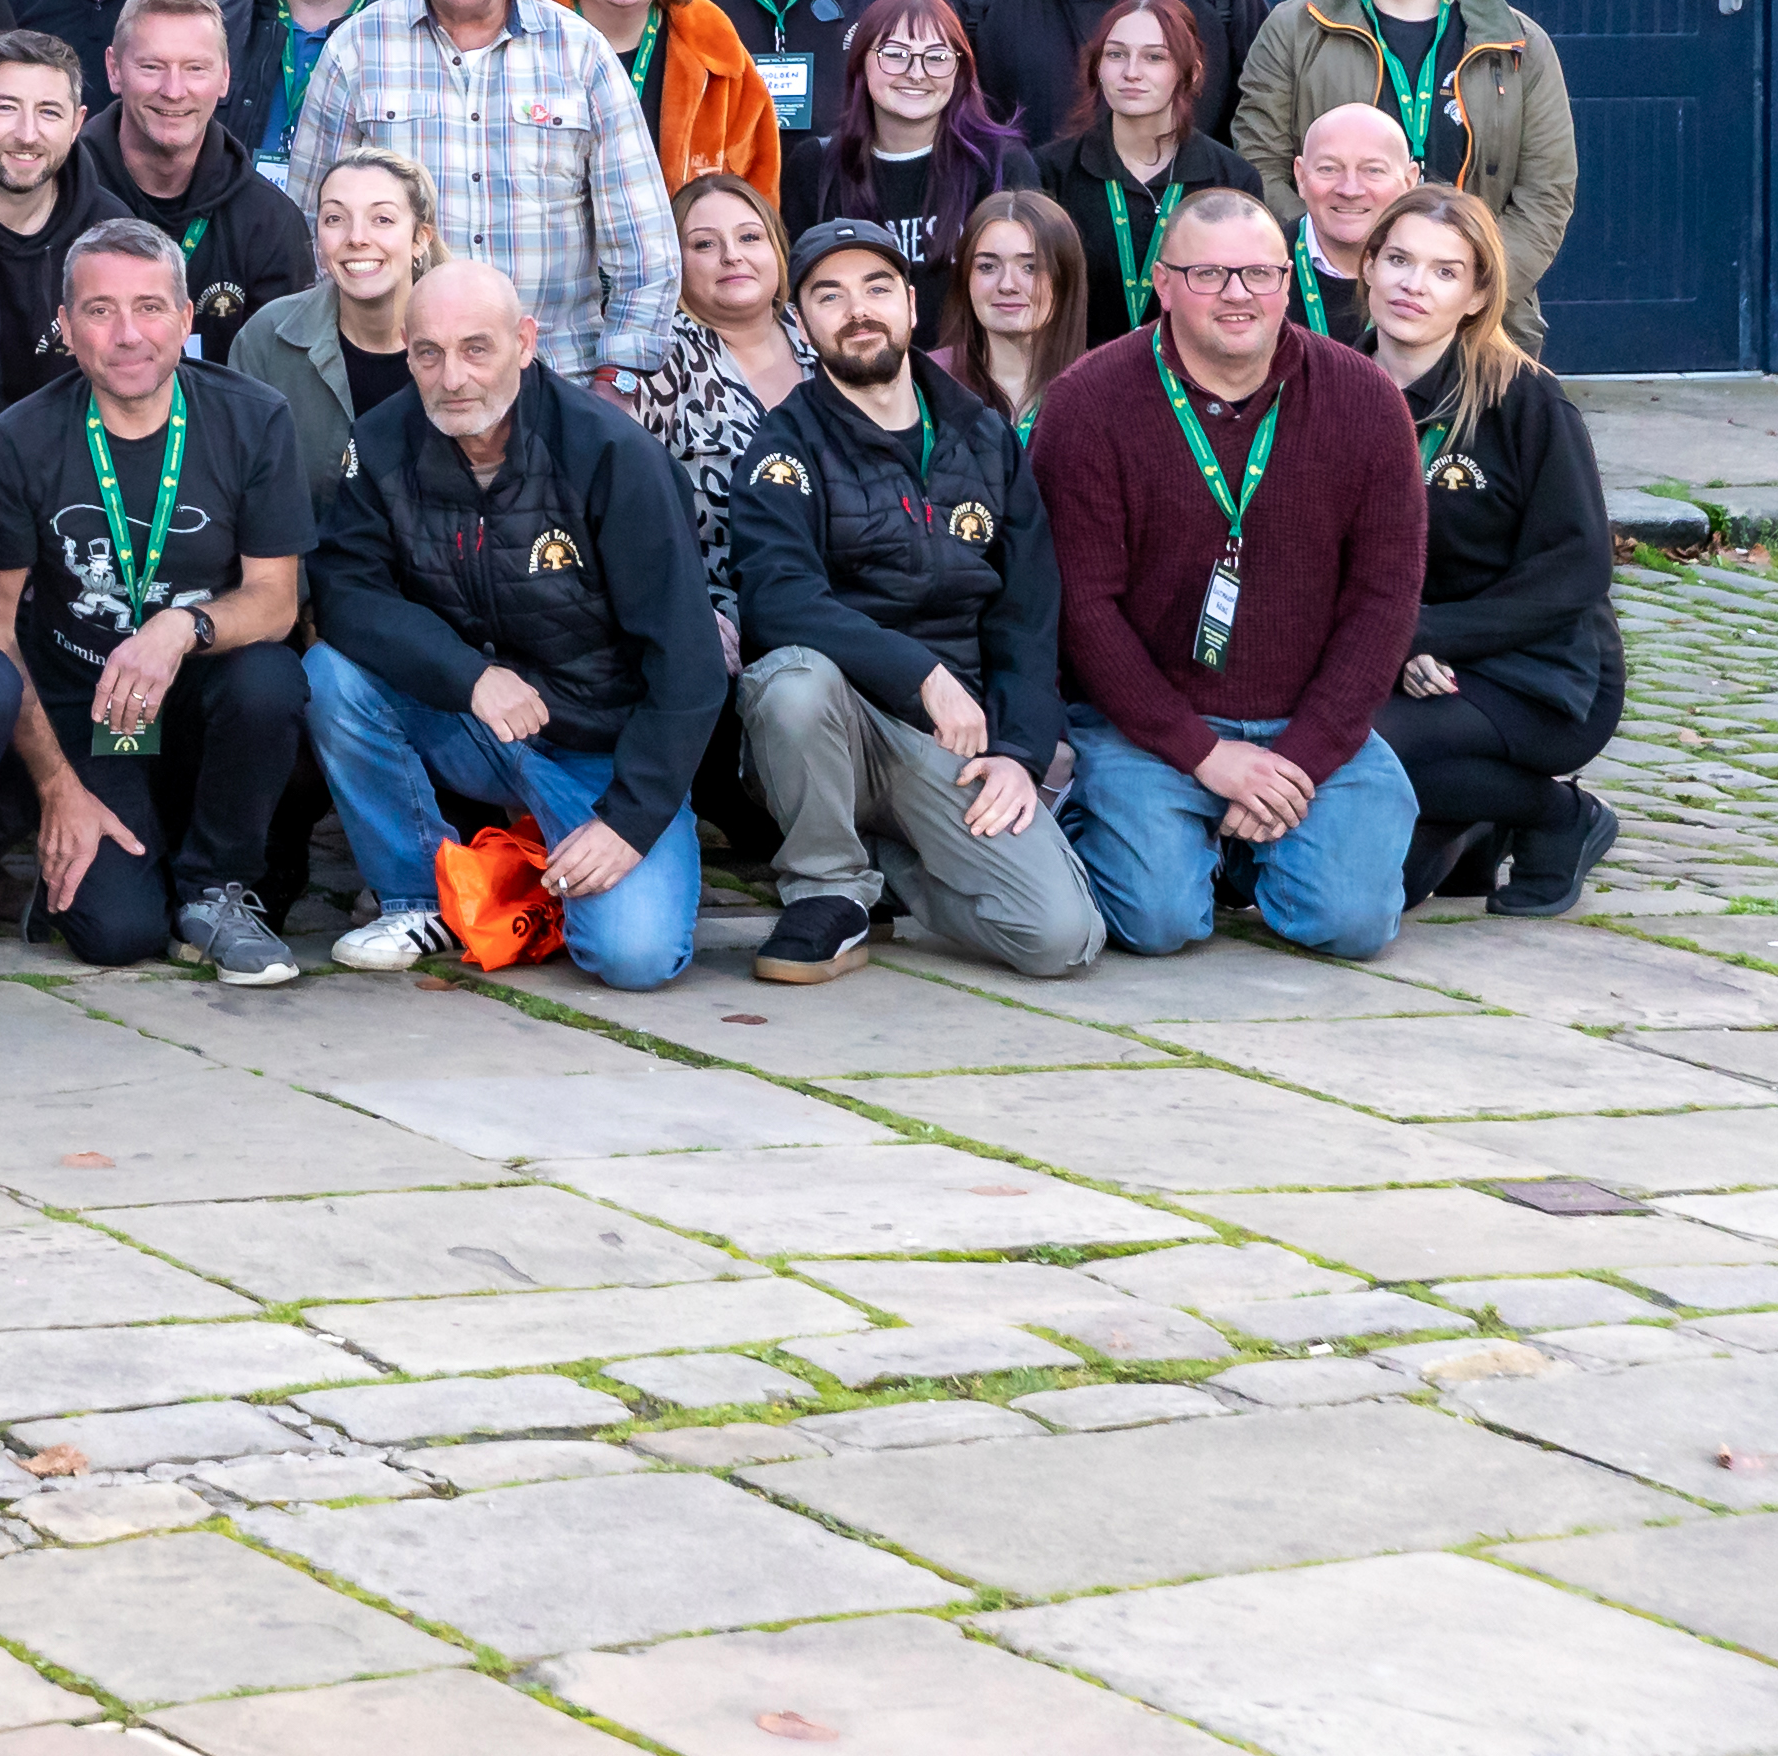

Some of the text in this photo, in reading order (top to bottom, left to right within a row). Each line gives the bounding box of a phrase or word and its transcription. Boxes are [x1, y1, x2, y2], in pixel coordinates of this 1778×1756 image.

[195, 281, 221, 315] TIMOTHY
[785, 453, 813, 496] TAYLOR'S
[1457, 453, 1487, 490] TAYLOR'S
[528, 529, 551, 574] TIMOTHY
[53, 629, 107, 666] Tamin
